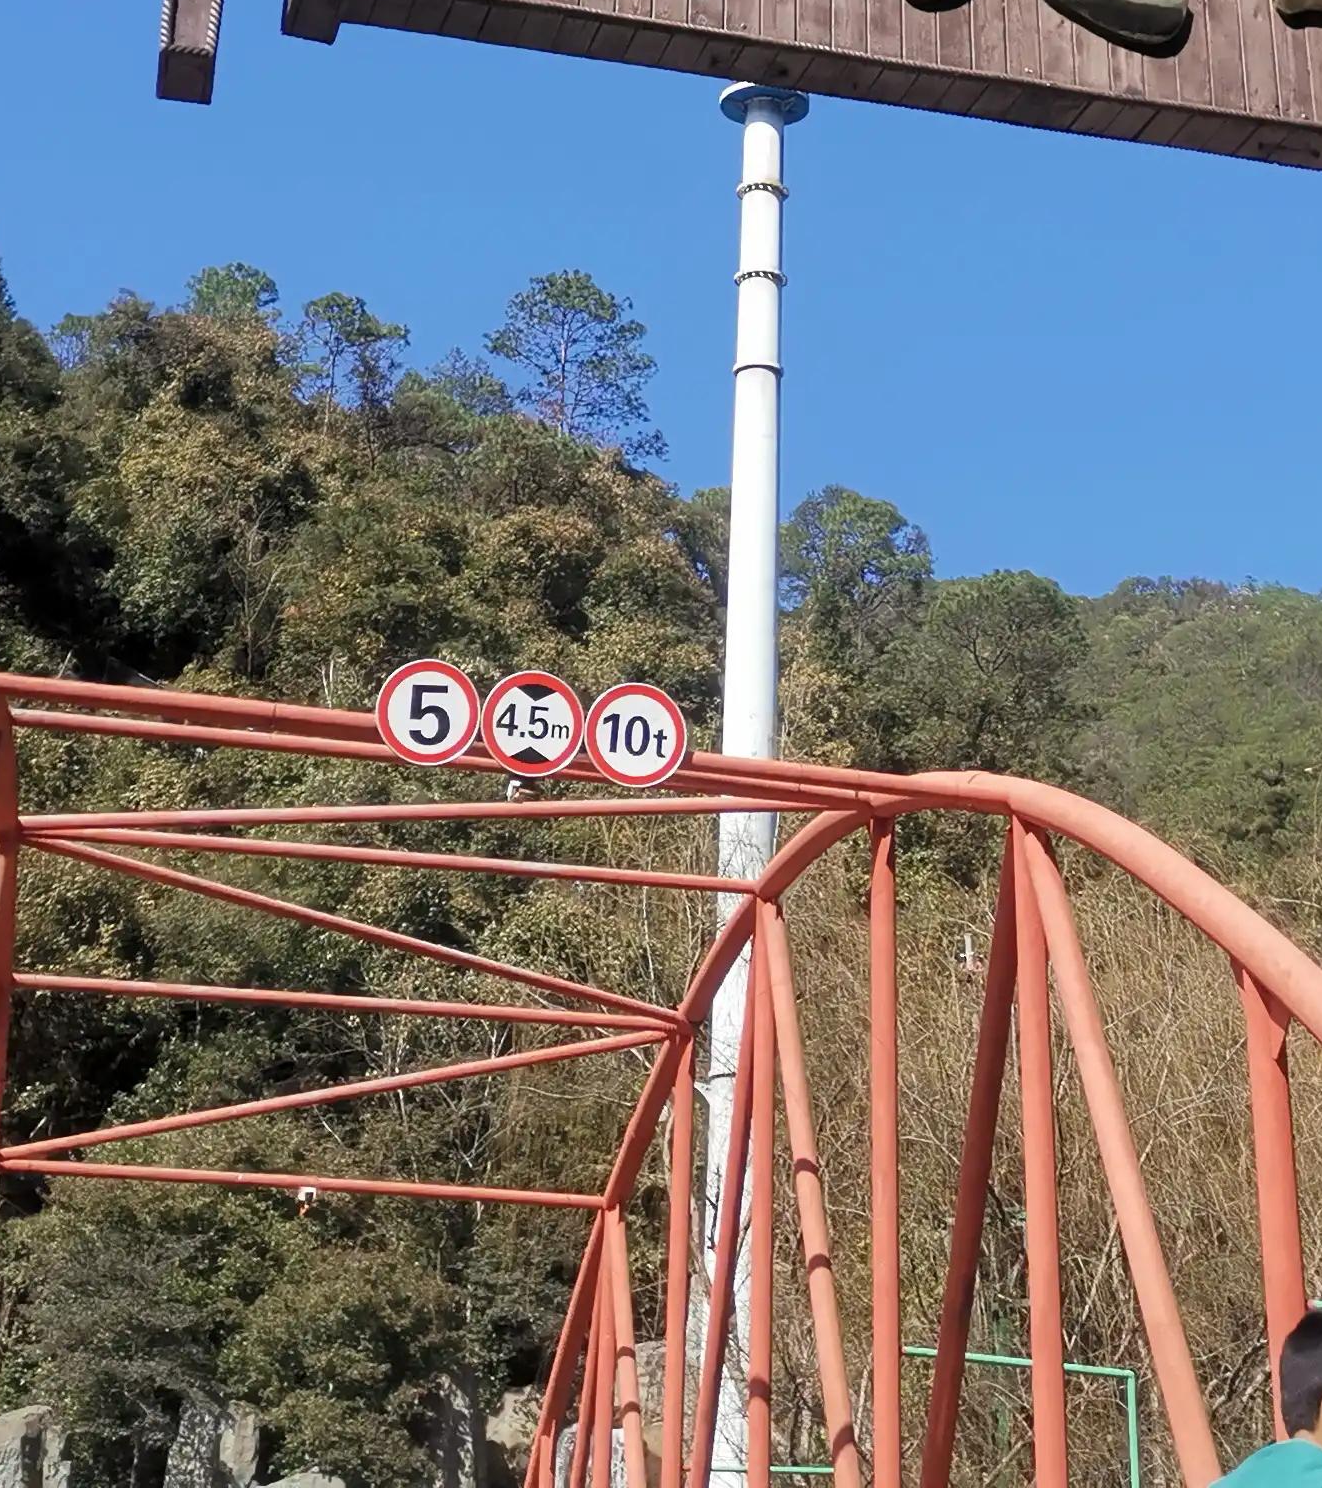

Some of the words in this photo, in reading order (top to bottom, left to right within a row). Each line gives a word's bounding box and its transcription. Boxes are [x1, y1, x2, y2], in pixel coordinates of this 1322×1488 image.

[409, 684, 451, 746] 5
[495, 703, 570, 741] 4.5m
[602, 713, 668, 758] 10t
